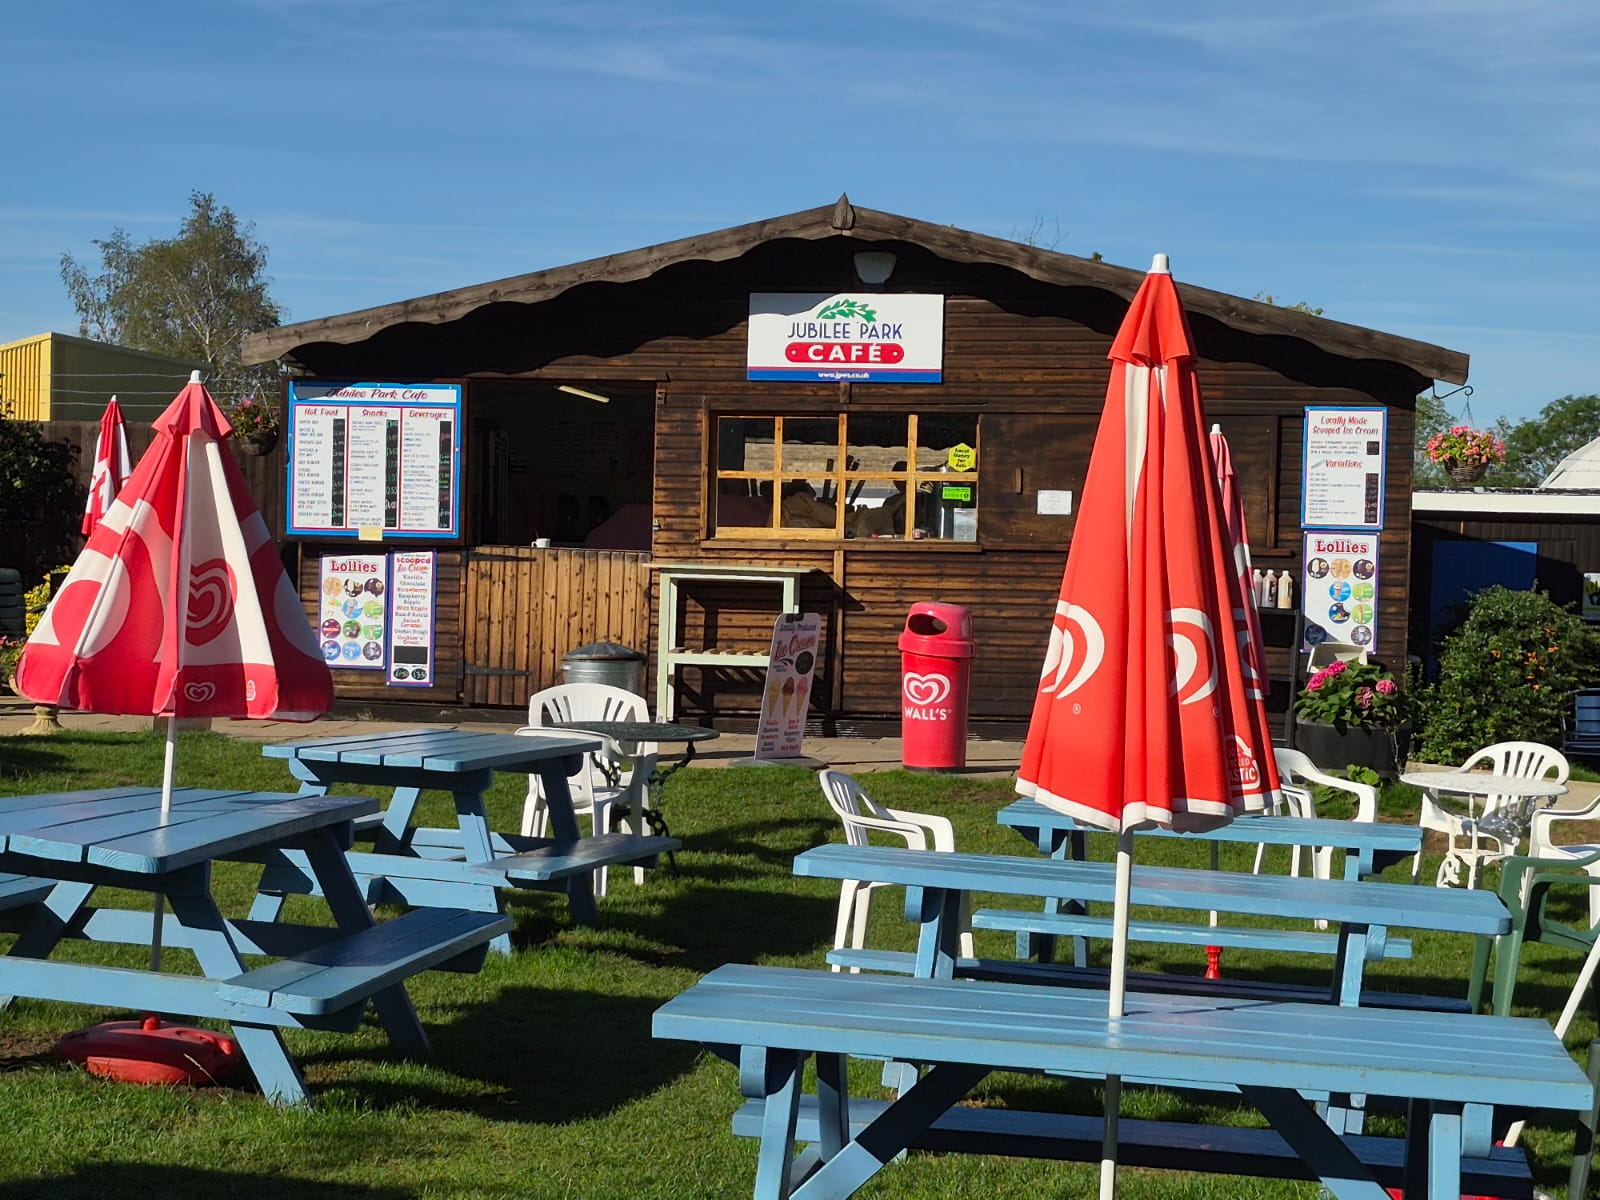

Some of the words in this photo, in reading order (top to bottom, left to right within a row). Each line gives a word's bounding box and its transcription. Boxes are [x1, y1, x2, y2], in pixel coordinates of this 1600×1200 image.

[787, 322, 851, 339] JUBILEE
[860, 323, 903, 340] PARK
[808, 343, 881, 361] CAFÉ
[370, 389, 398, 399] Park
[304, 408, 316, 416] Hot
[1321, 416, 1346, 426] Locally
[1348, 416, 1368, 425] Made
[1313, 425, 1340, 436] Scooped
[1343, 426, 1353, 434] Ice
[1355, 426, 1379, 435] Cream
[1315, 540, 1369, 554] Lollies
[330, 559, 377, 573] Lollies
[904, 707, 947, 720] WALL'S
